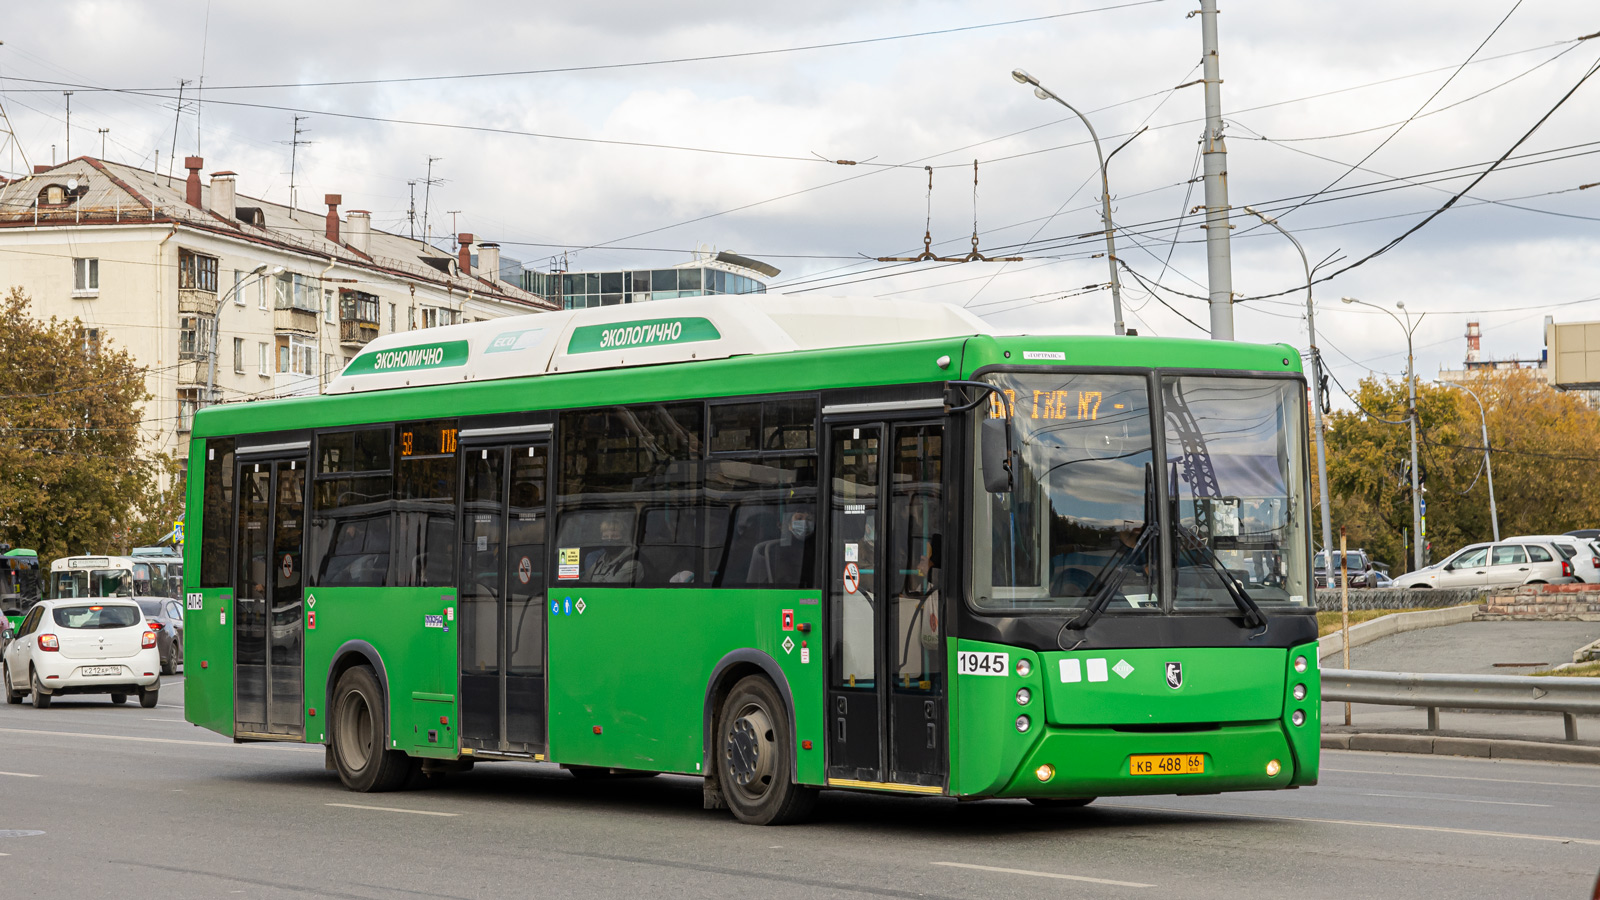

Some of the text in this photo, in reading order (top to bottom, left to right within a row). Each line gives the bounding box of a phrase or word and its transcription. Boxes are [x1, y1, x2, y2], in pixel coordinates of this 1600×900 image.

[600, 321, 682, 348] ЭКОЛОГИЧНО
[374, 347, 444, 370] ЭКОНОМИЧНО
[402, 431, 413, 456] 58
[187, 594, 202, 609] АП-6
[960, 653, 1005, 673] 1945
[1137, 756, 1200, 772] КВ 488 66
